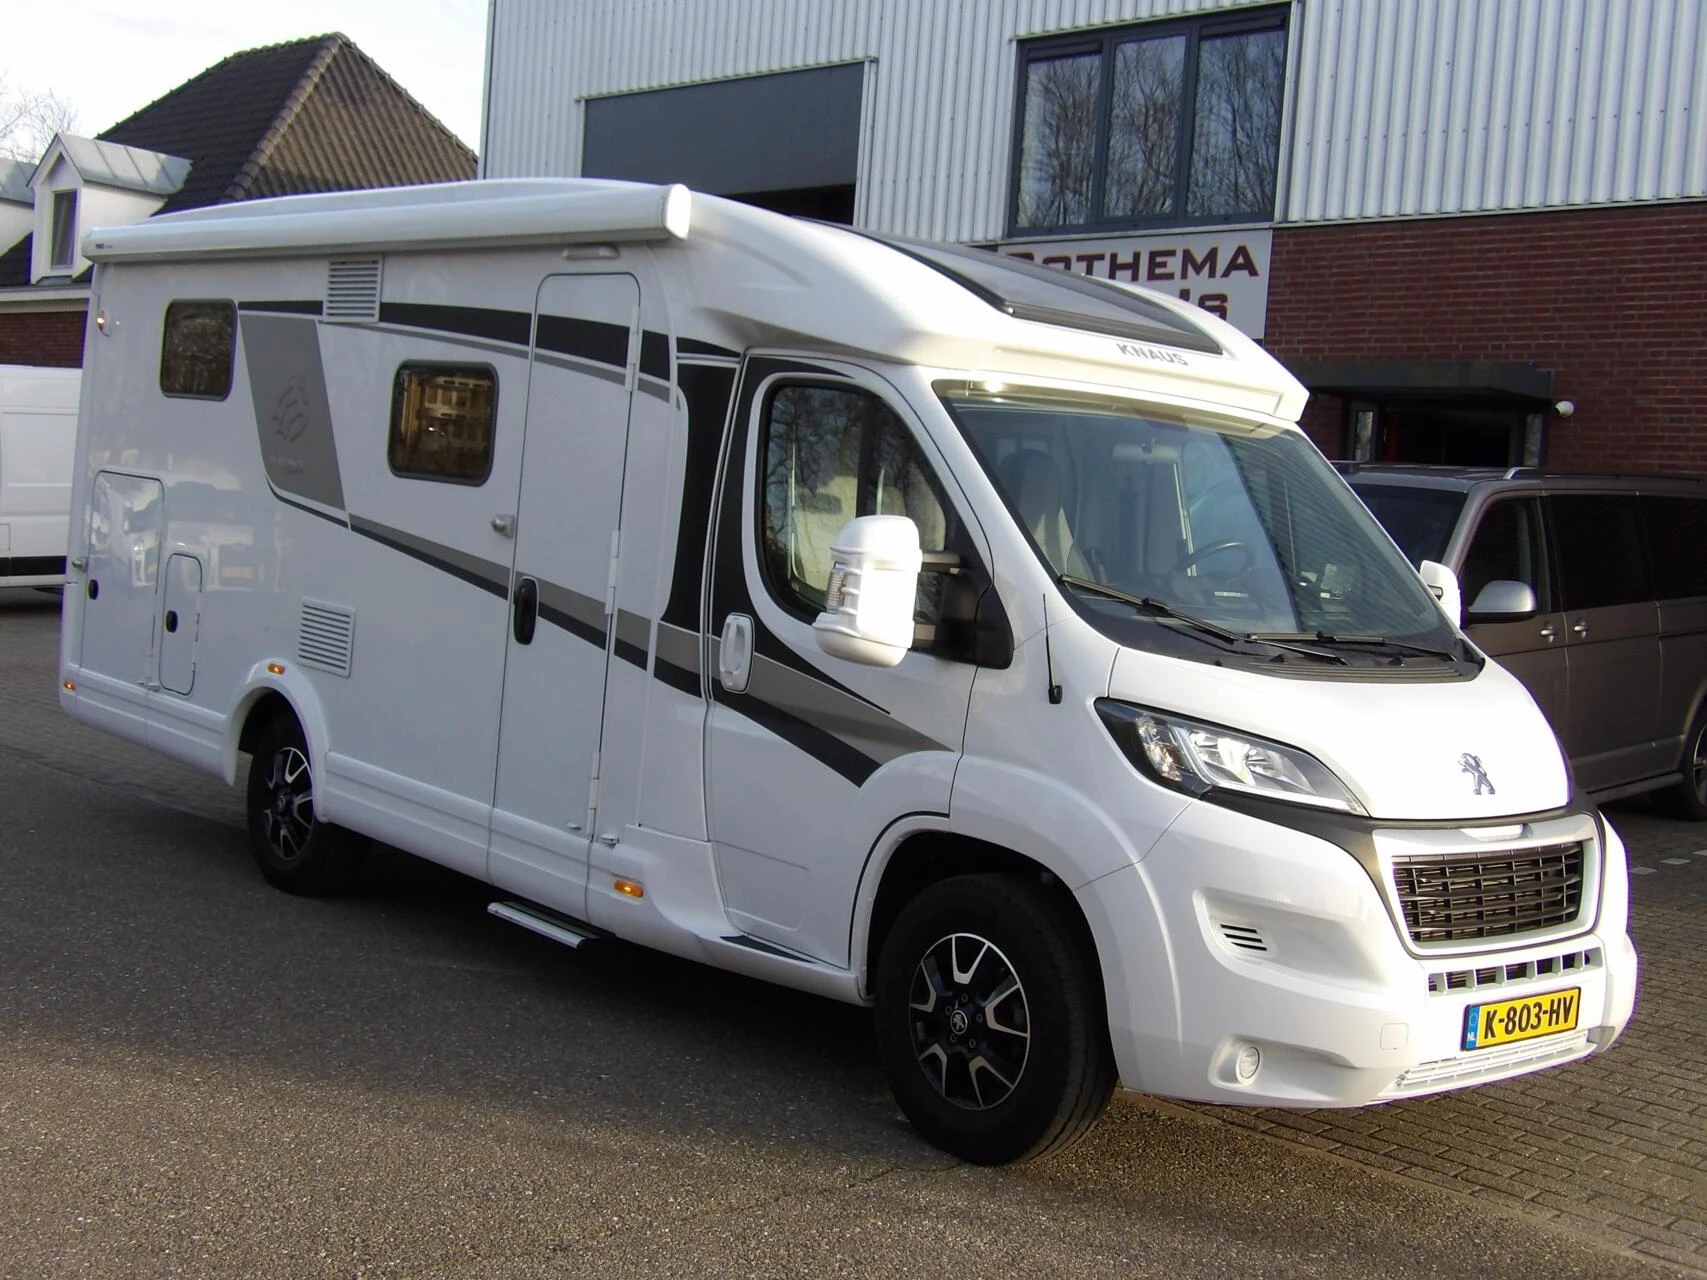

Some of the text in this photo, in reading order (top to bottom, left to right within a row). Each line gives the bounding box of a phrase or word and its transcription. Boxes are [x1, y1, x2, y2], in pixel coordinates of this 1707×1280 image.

[1116, 343, 1189, 366] KNAUS
[1484, 995, 1574, 1039] K-803-HV
[1467, 1032, 1476, 1041] NL
